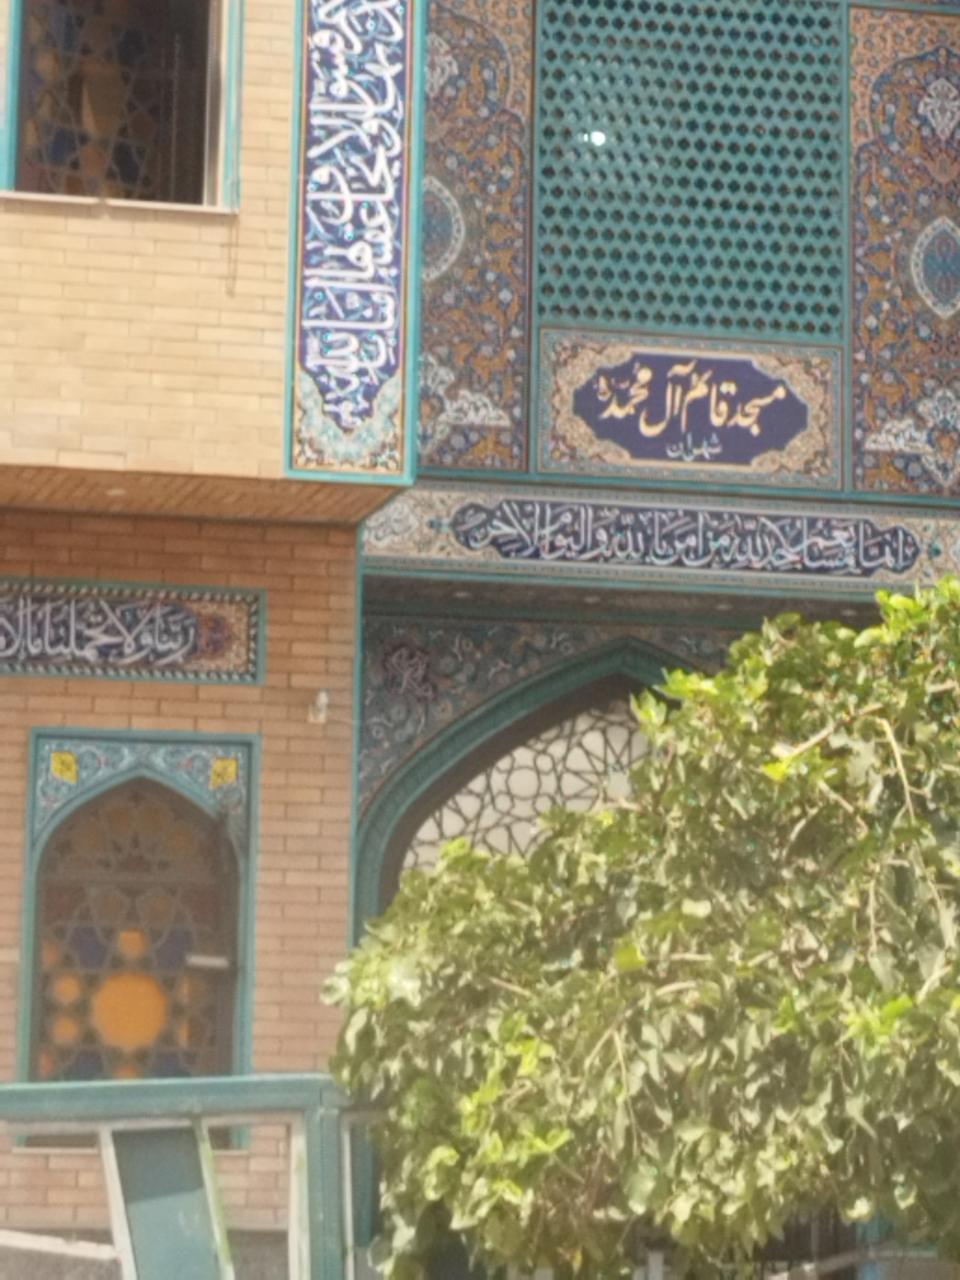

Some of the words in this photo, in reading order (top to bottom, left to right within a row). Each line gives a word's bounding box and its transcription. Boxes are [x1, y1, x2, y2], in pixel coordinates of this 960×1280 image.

[599, 362, 653, 420] محمد
[638, 359, 698, 438] آل
[680, 369, 738, 434] قائم
[727, 383, 787, 437] مسجد
